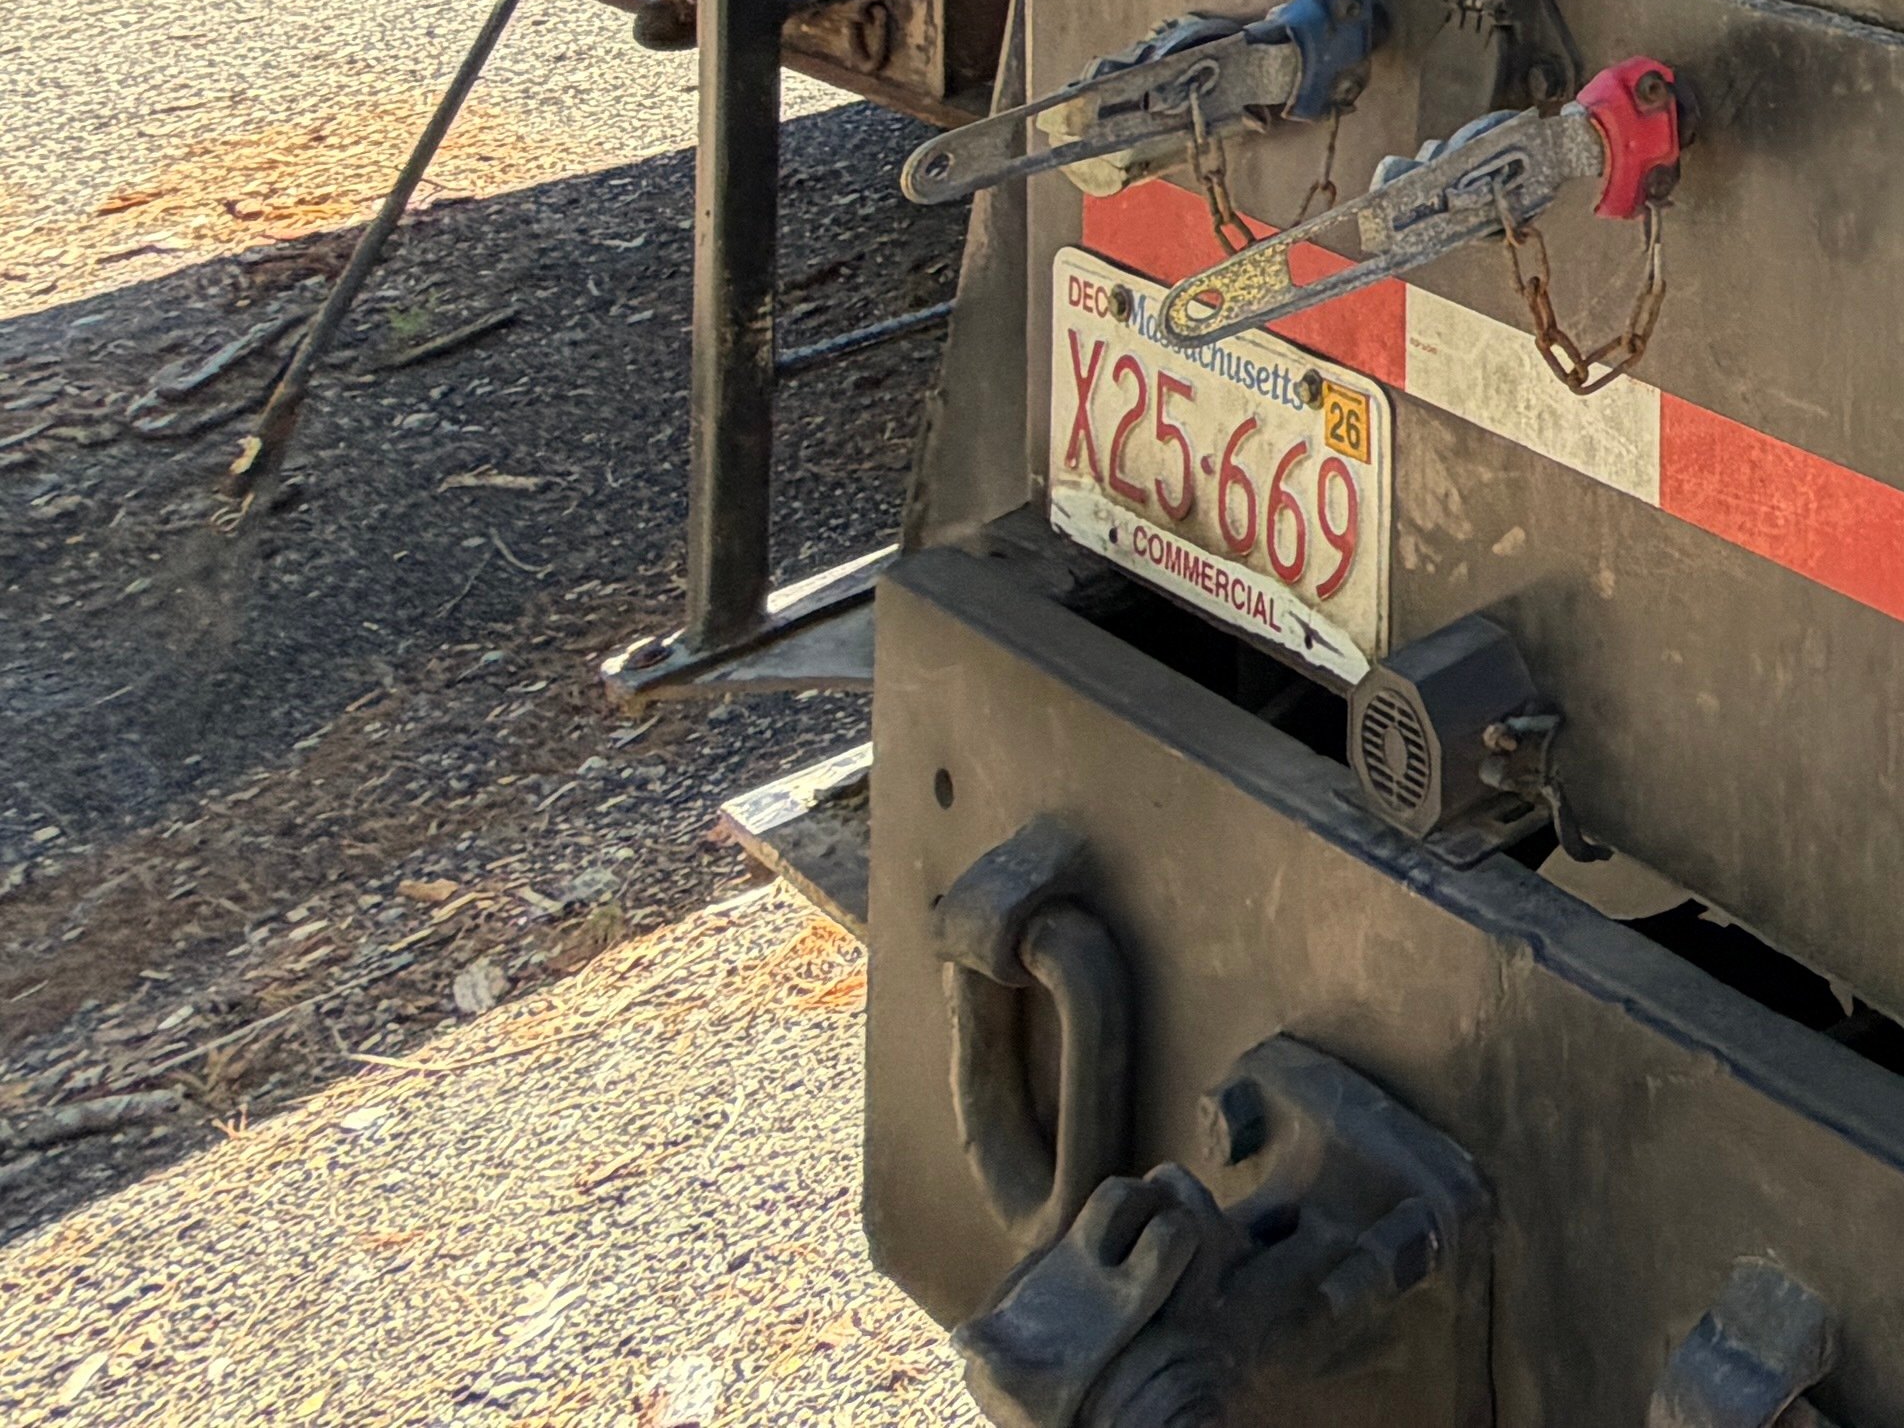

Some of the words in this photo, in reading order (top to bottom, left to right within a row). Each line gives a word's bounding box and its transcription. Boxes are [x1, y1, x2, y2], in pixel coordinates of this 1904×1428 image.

[1068, 275, 1110, 318] DEC
[1329, 401, 1361, 450] 26
[1132, 525, 1283, 633] COMMERCIAL
